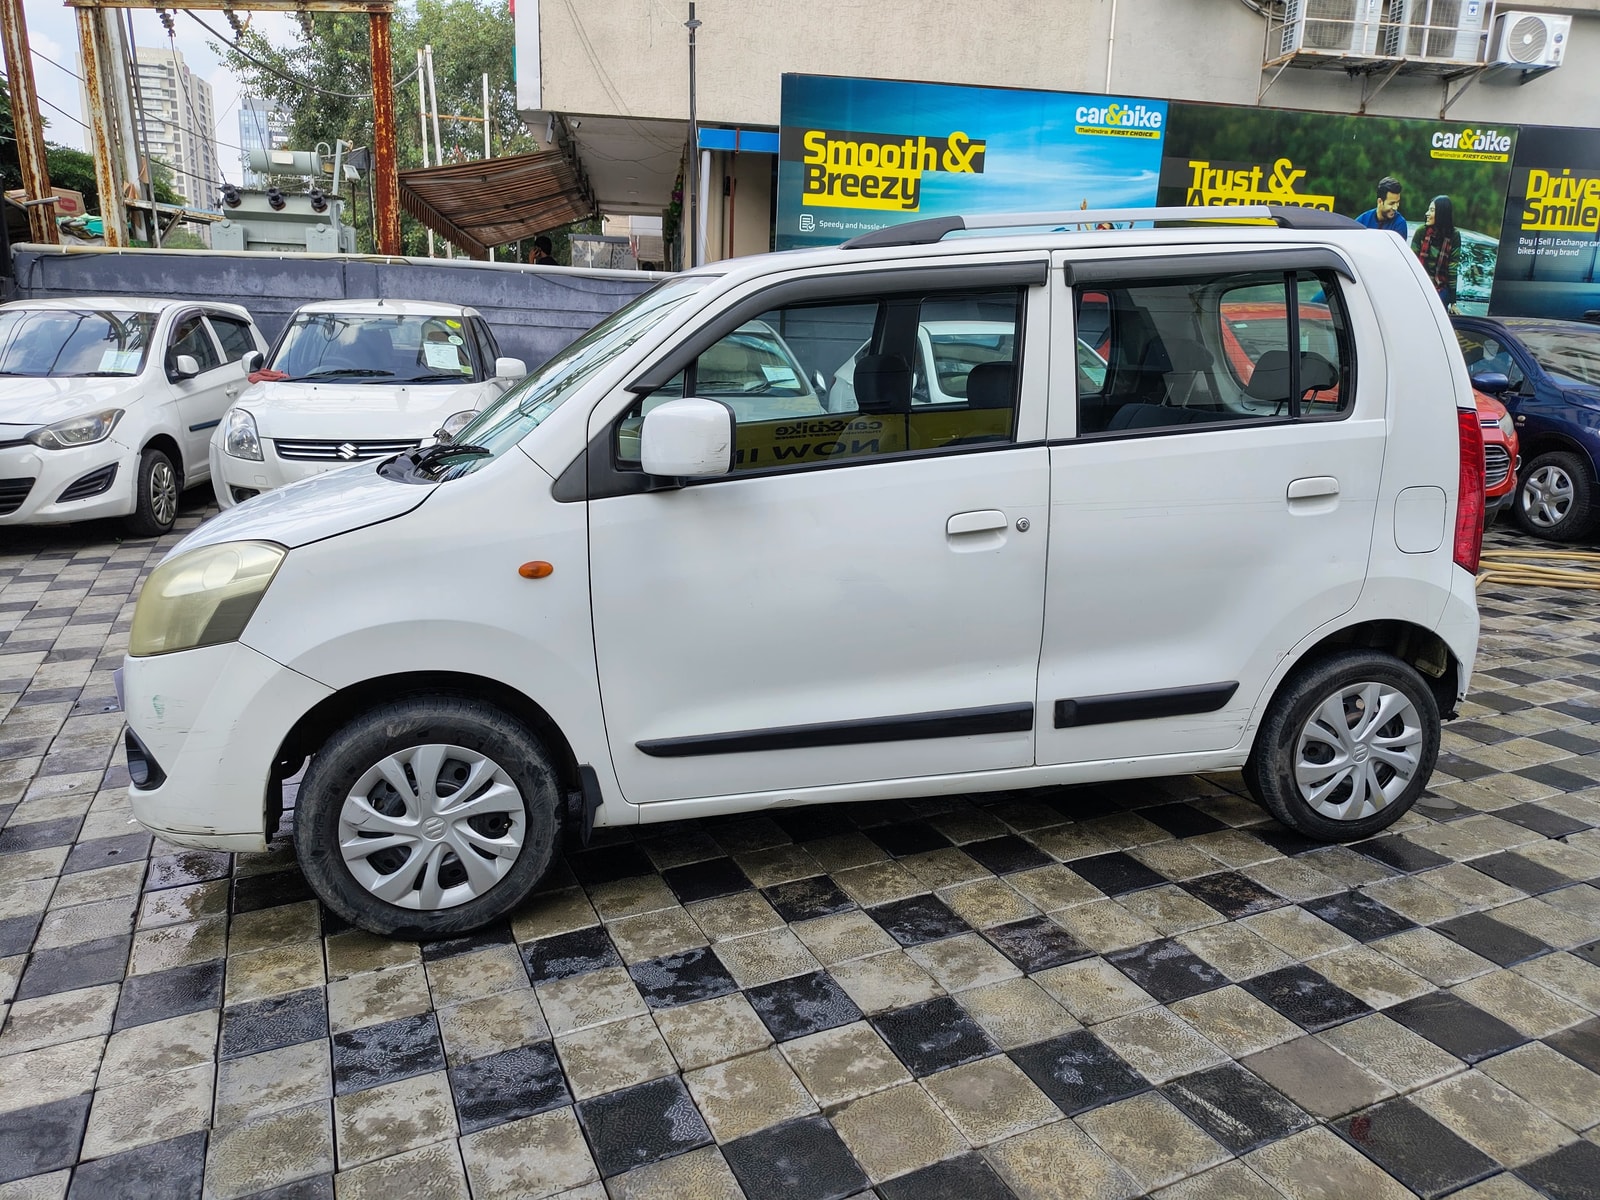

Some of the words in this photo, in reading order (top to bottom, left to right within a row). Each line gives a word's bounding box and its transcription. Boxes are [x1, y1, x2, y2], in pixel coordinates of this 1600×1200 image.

[1075, 103, 1162, 128] car&bike
[803, 130, 937, 171] Smooth
[942, 131, 986, 173] &
[1432, 128, 1511, 151] car&bike
[804, 164, 920, 209] Breezy
[1188, 161, 1263, 193] Trust
[1268, 158, 1306, 194] &
[1526, 168, 1600, 200] Drive
[819, 220, 844, 230] Speedy
[1521, 198, 1598, 226] Smile
[1518, 247, 1535, 255] bikes
[1519, 237, 1533, 246] Buy
[1556, 239, 1588, 248] Exchange
